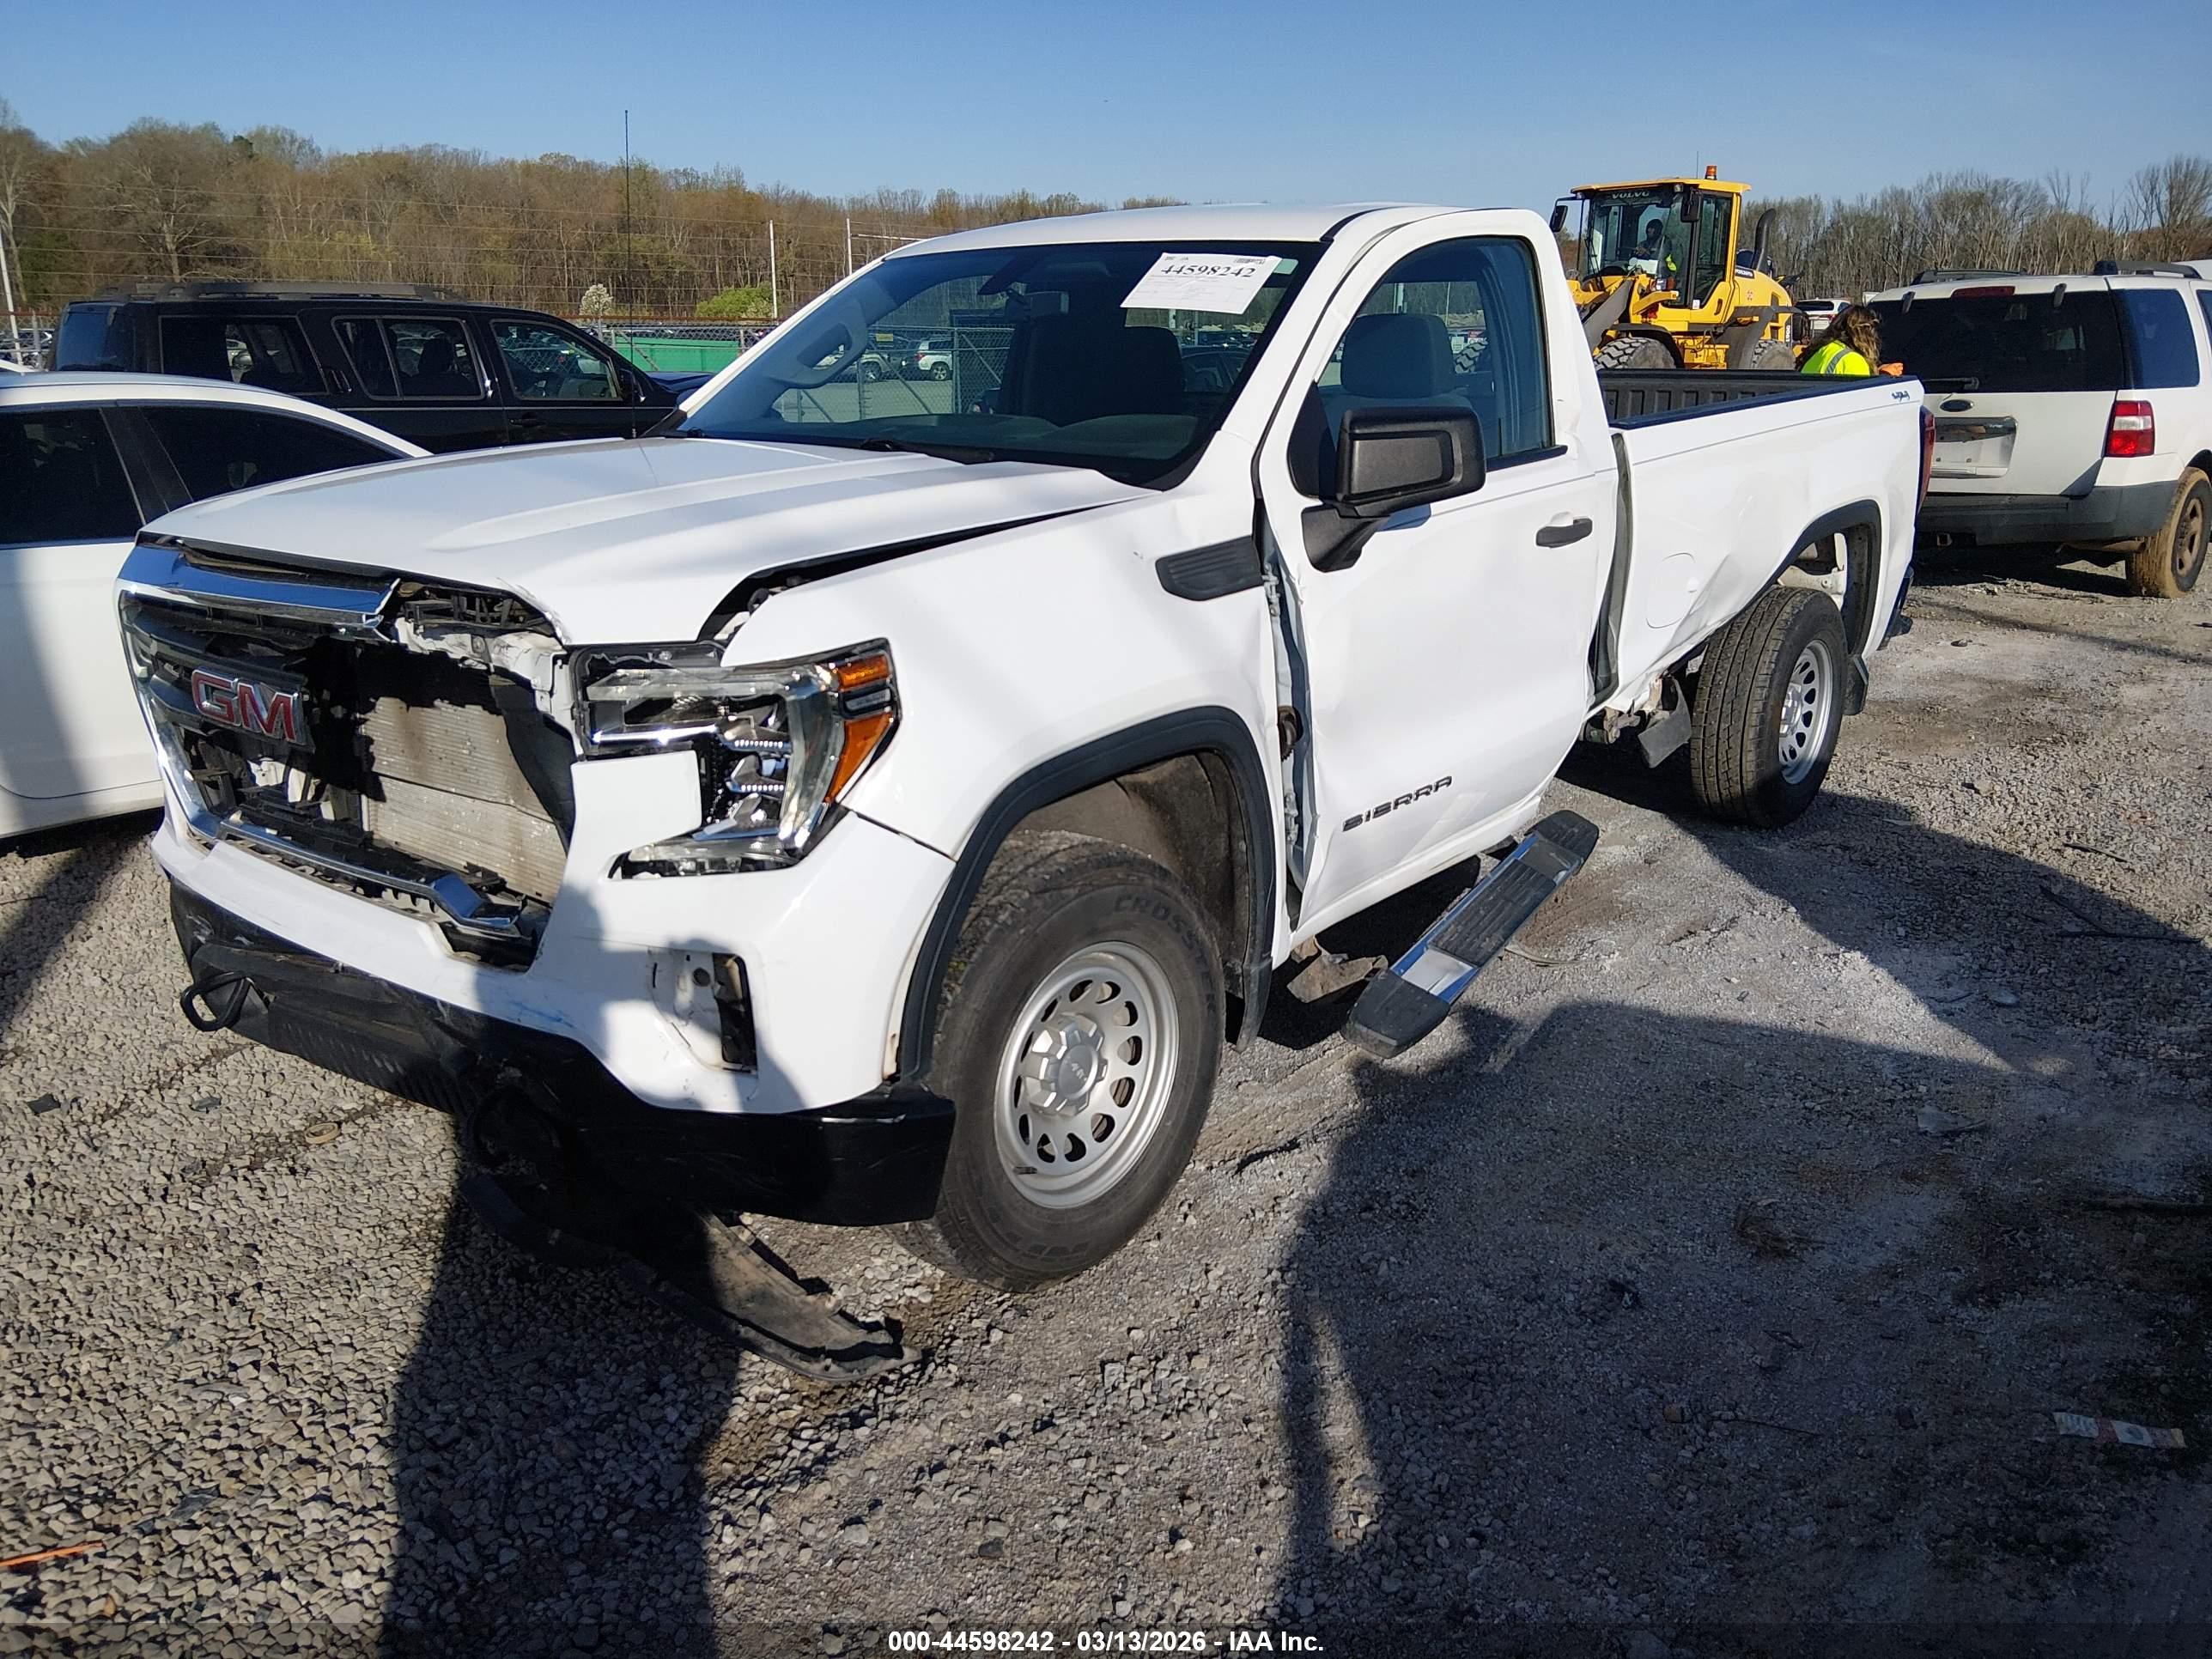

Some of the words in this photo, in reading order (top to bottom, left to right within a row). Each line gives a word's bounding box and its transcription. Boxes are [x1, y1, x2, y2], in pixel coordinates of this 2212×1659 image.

[1612, 191, 1650, 199] VOLVO
[1161, 264, 1255, 277] 44598242
[1342, 775, 1452, 832] SIERRA
